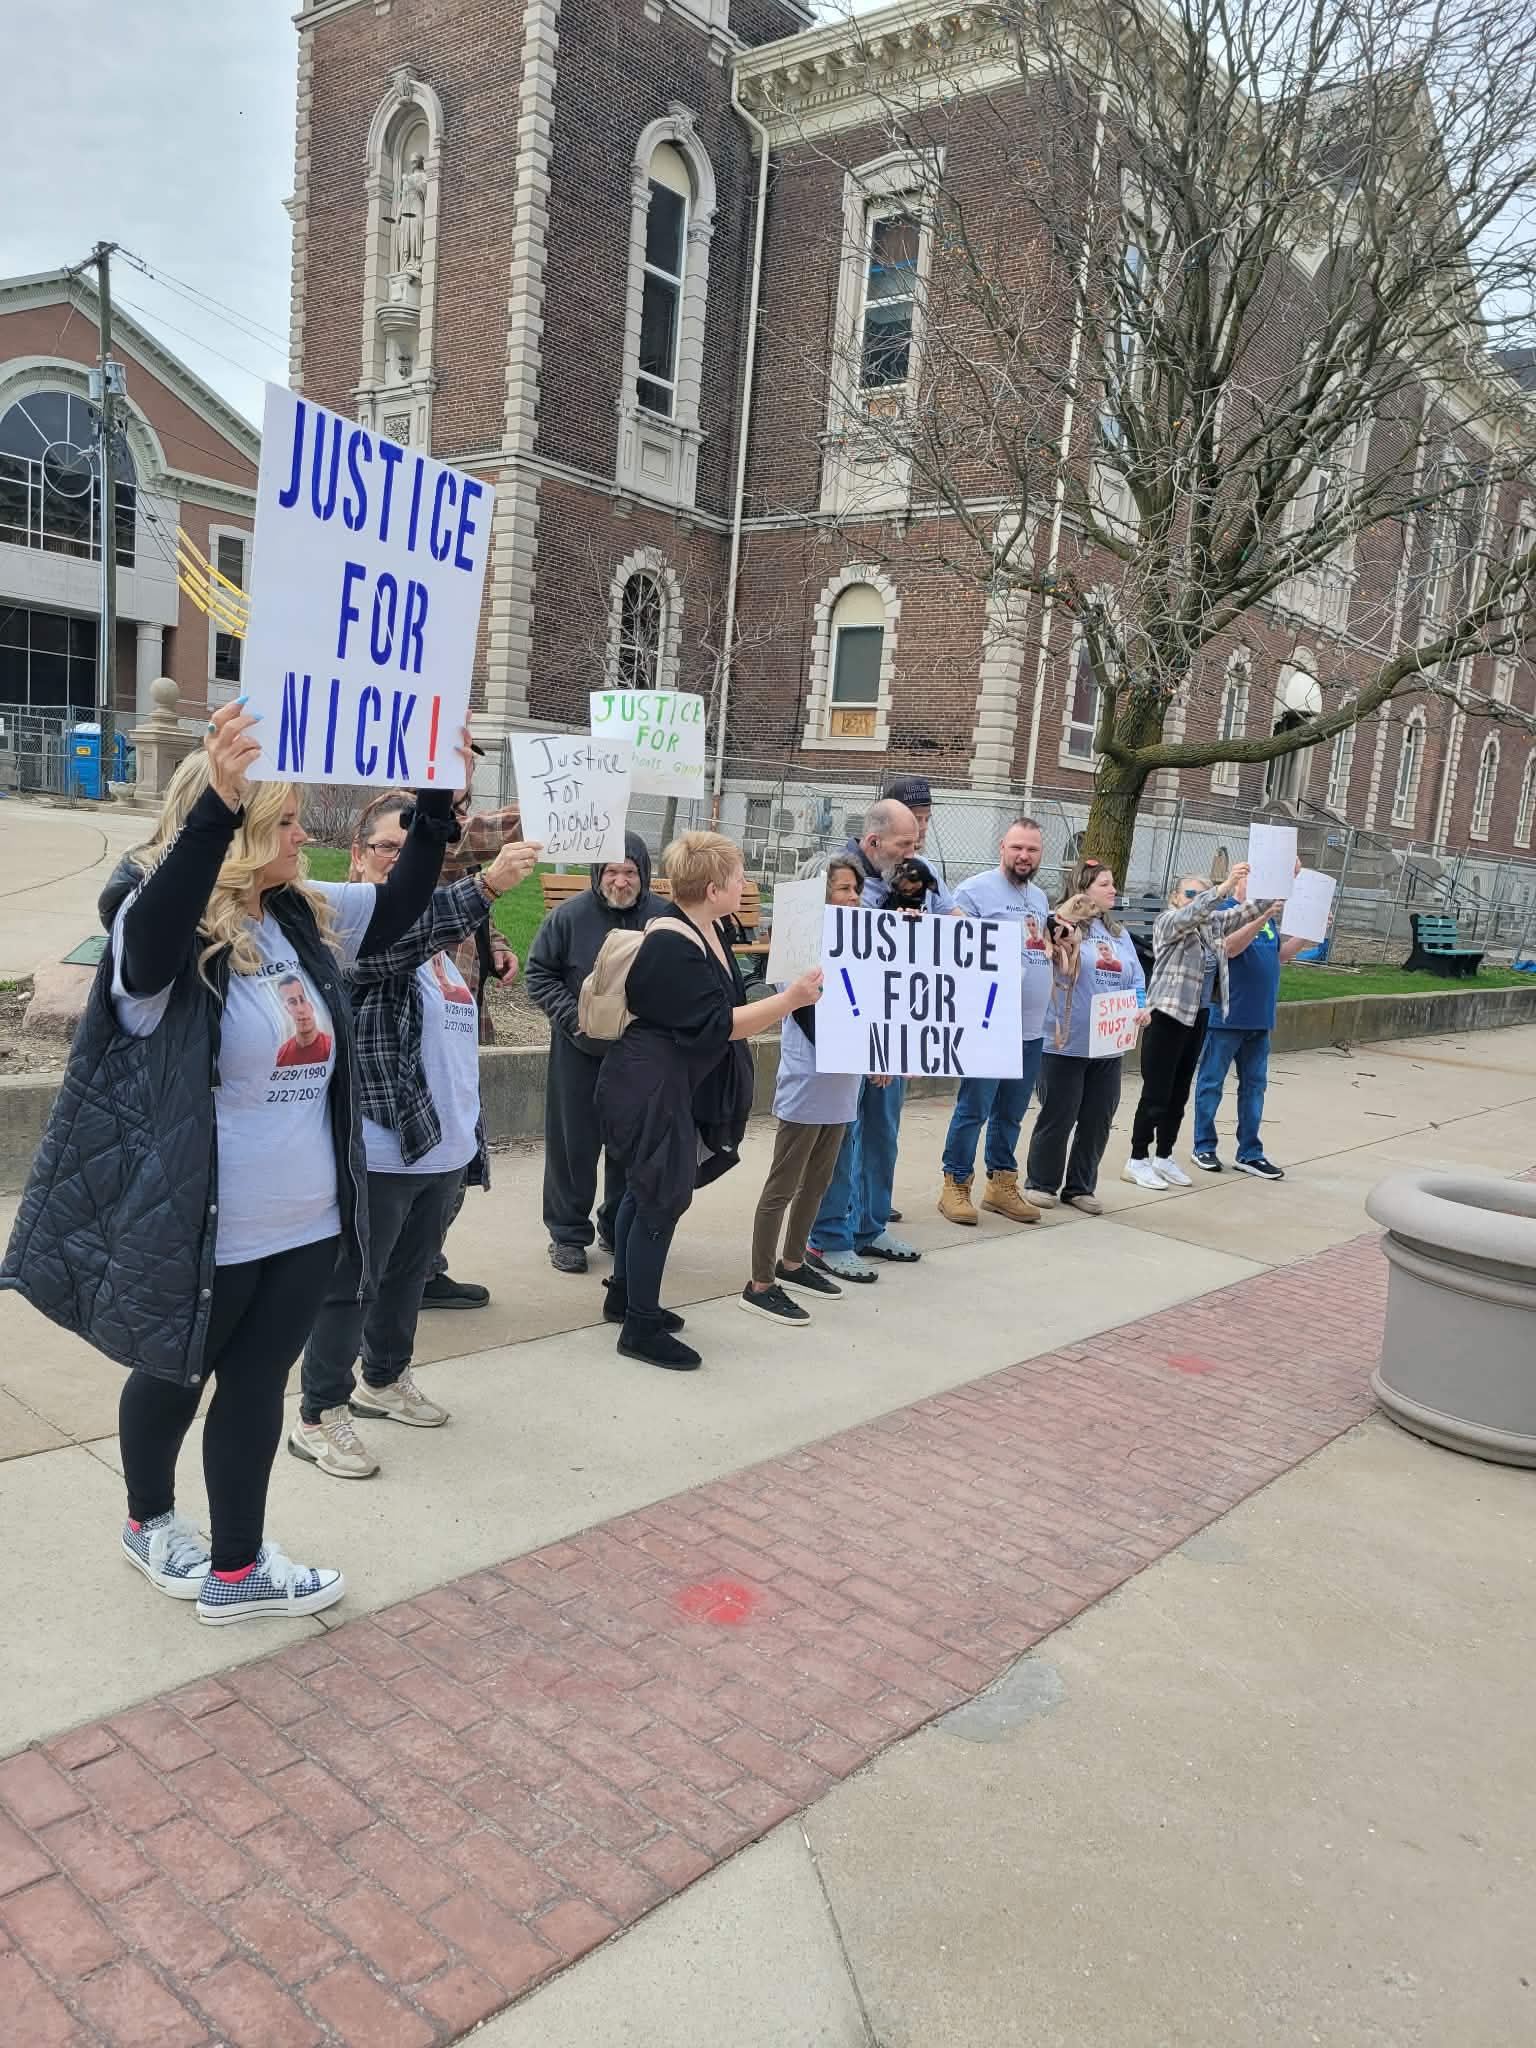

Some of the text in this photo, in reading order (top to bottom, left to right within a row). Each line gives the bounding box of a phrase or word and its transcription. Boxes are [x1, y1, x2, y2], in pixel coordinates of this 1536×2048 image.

[279, 401, 482, 572] JUSTICE
[337, 561, 428, 673] FOR
[278, 672, 440, 780] NICK!
[595, 694, 701, 725] JUSTICE
[530, 736, 627, 778] Justice
[636, 725, 679, 752] FOR
[829, 908, 999, 971] JUSTICE
[884, 970, 956, 1023] FOR
[869, 1022, 965, 1076] NICK
[1098, 1016, 1127, 1037] MUST
[270, 1066, 327, 1080] 8/29/1990
